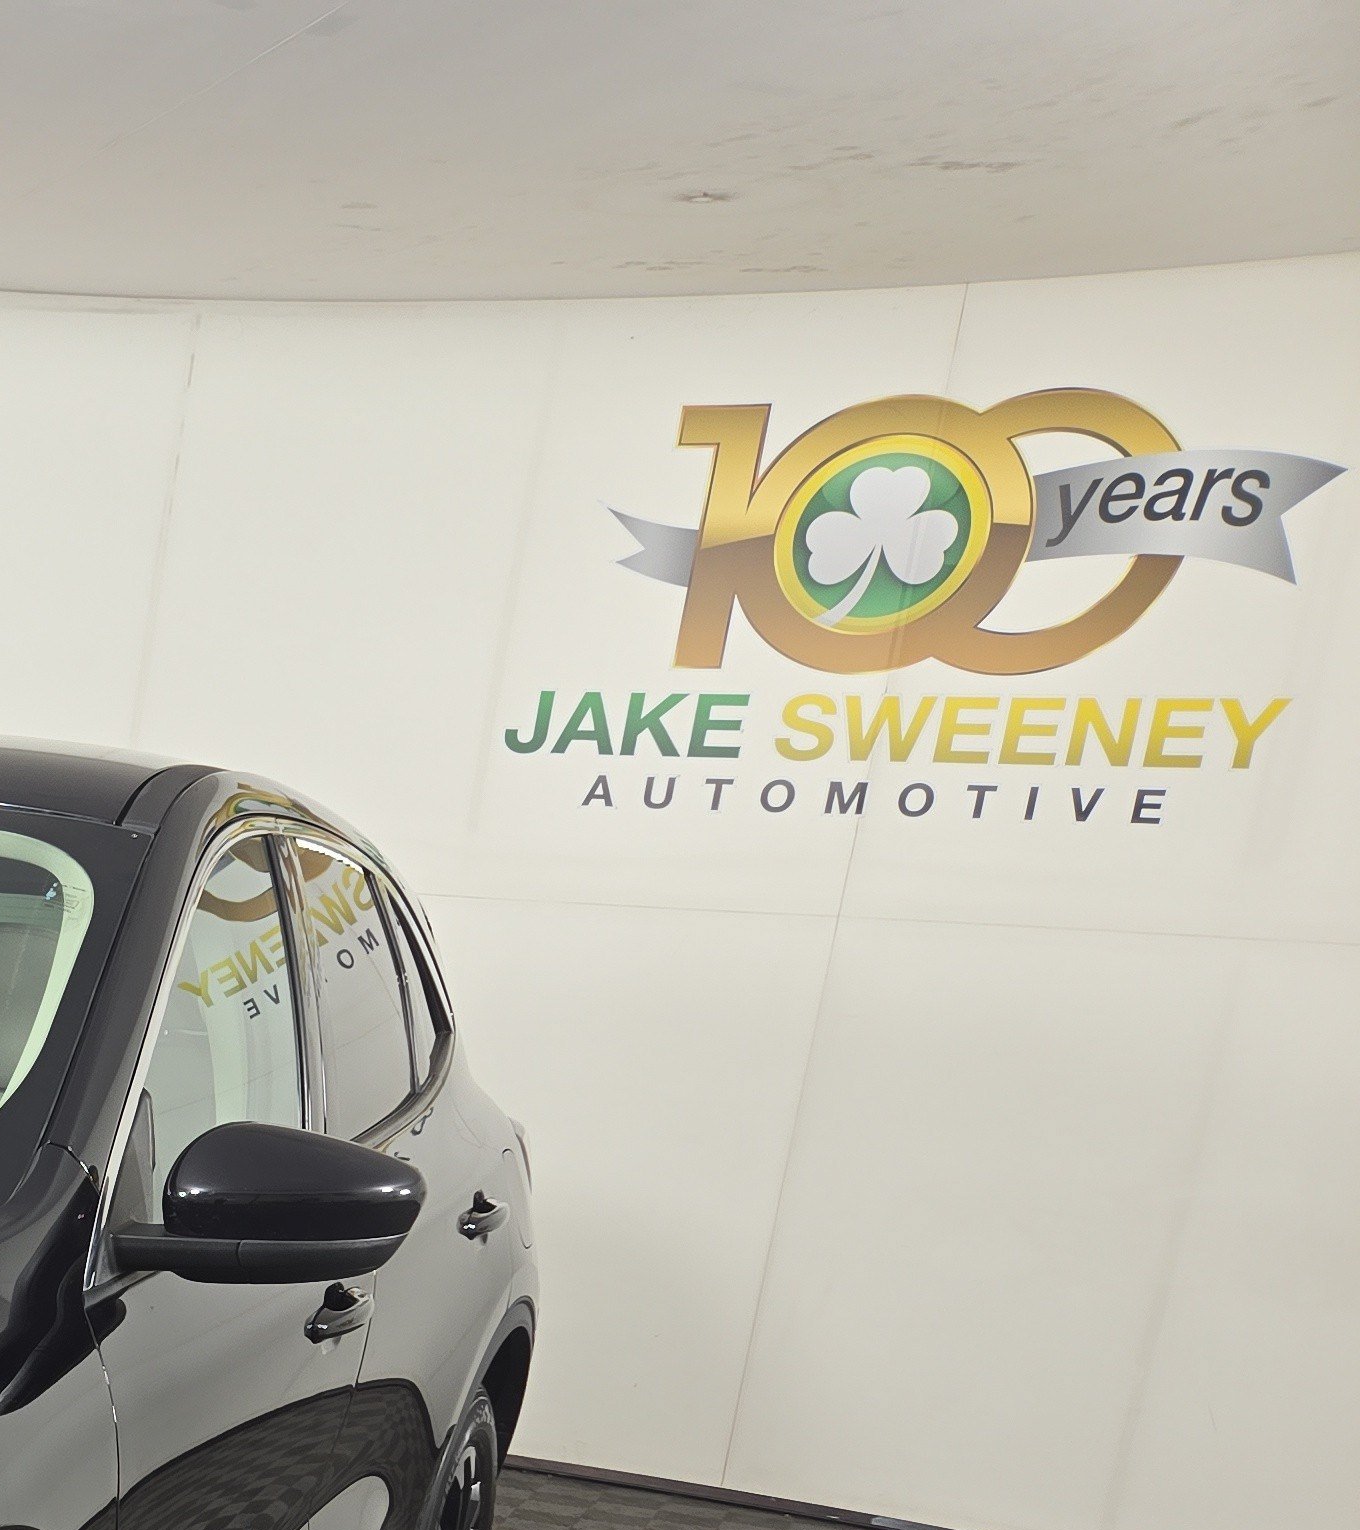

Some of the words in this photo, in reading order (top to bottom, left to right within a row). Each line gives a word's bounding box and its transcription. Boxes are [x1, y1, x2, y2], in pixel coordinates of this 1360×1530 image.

[1045, 466, 1271, 548] years
[504, 690, 750, 760] JAKE
[773, 693, 1293, 771] SWEENEY
[582, 774, 1167, 826] AUTOMOTIVE
